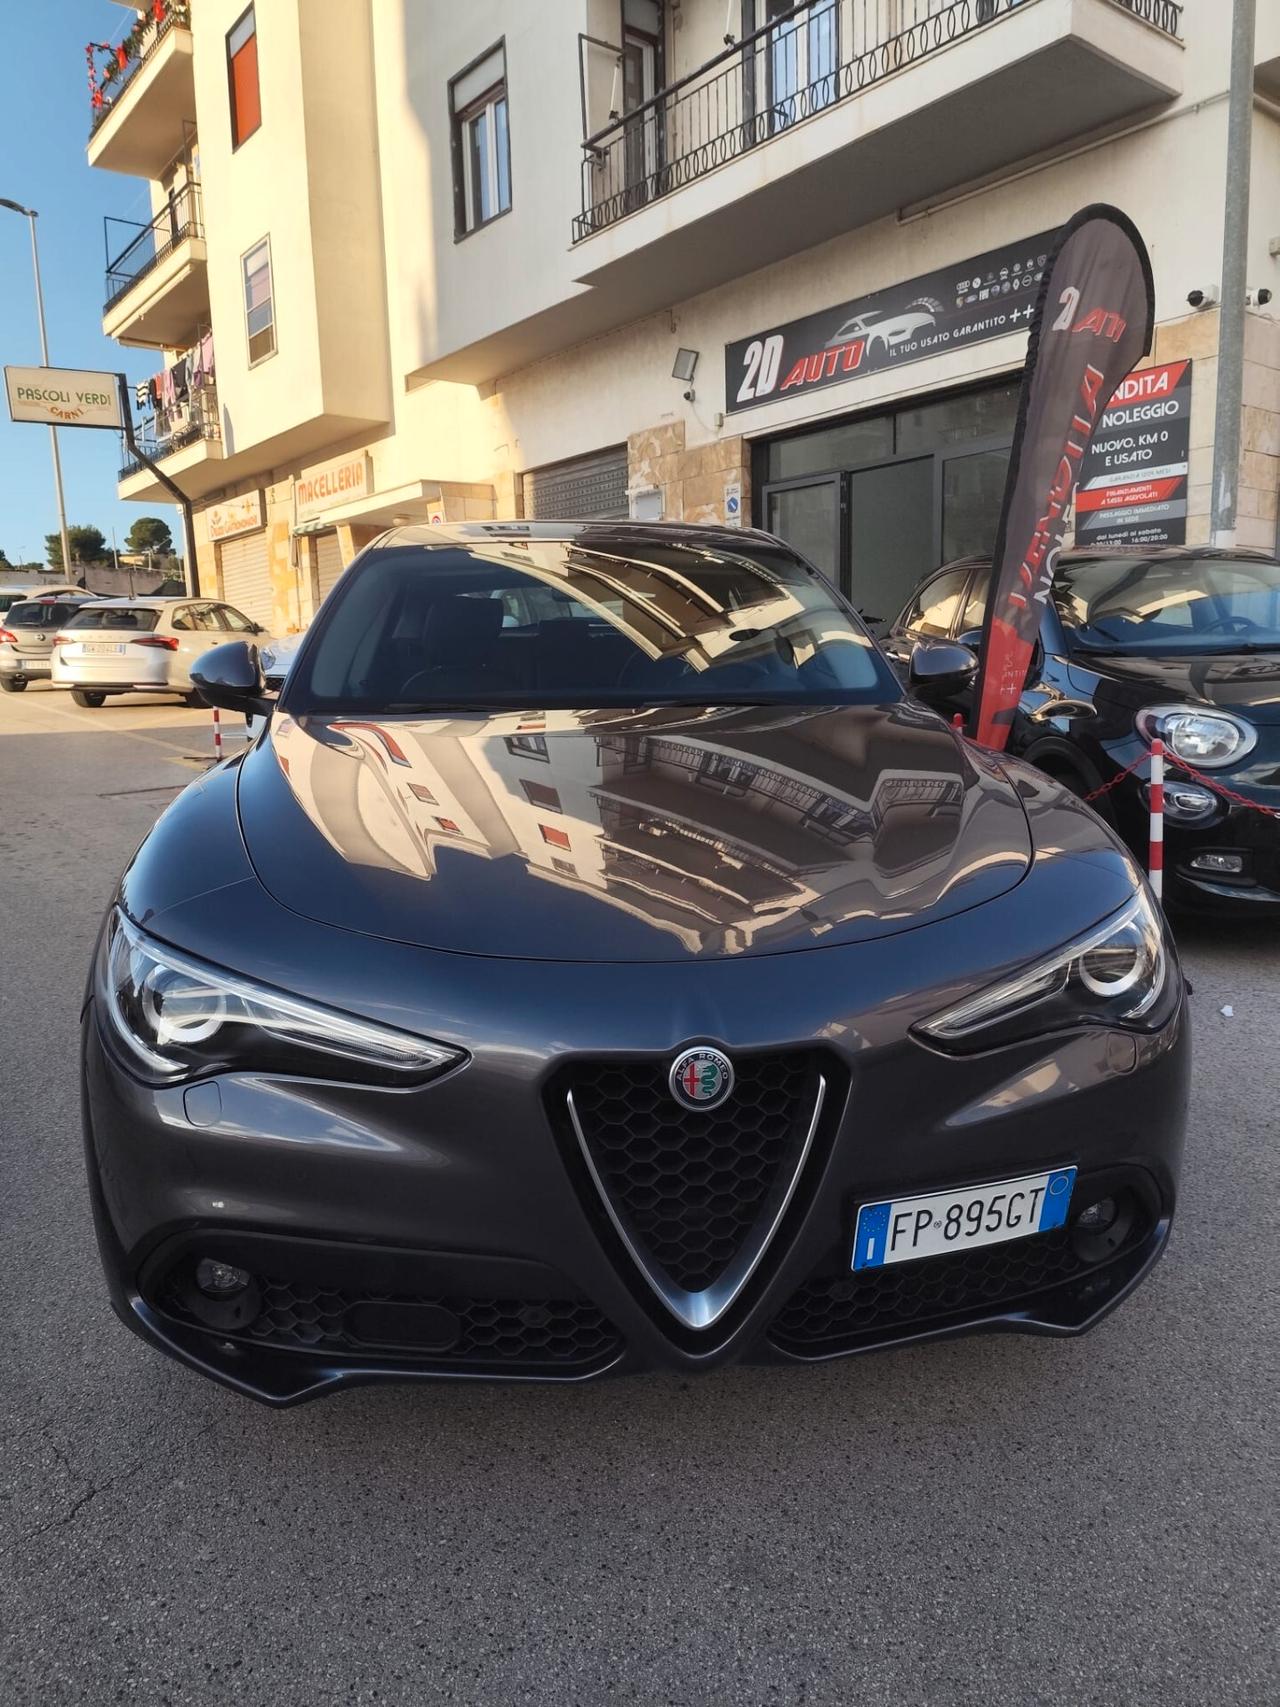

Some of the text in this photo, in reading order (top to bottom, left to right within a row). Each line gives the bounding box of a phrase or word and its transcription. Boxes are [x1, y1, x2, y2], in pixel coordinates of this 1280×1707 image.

[900, 342, 918, 354] TUO
[920, 331, 951, 348] USATO
[952, 315, 1006, 339] GARANTITO
[780, 339, 865, 391] AUTO
[16, 387, 112, 406] PASCOLI VERDI
[1110, 371, 1168, 402] NDITA
[49, 406, 85, 420] CARNI
[1102, 400, 1179, 429] NOLEGGIO
[1138, 433, 1158, 446] KM
[1105, 449, 1153, 467] E USATO
[298, 461, 363, 505] MACELLERIA
[1134, 504, 1169, 513] IMMEDIATO
[677, 1053, 729, 1081] ALFA ROMEO
